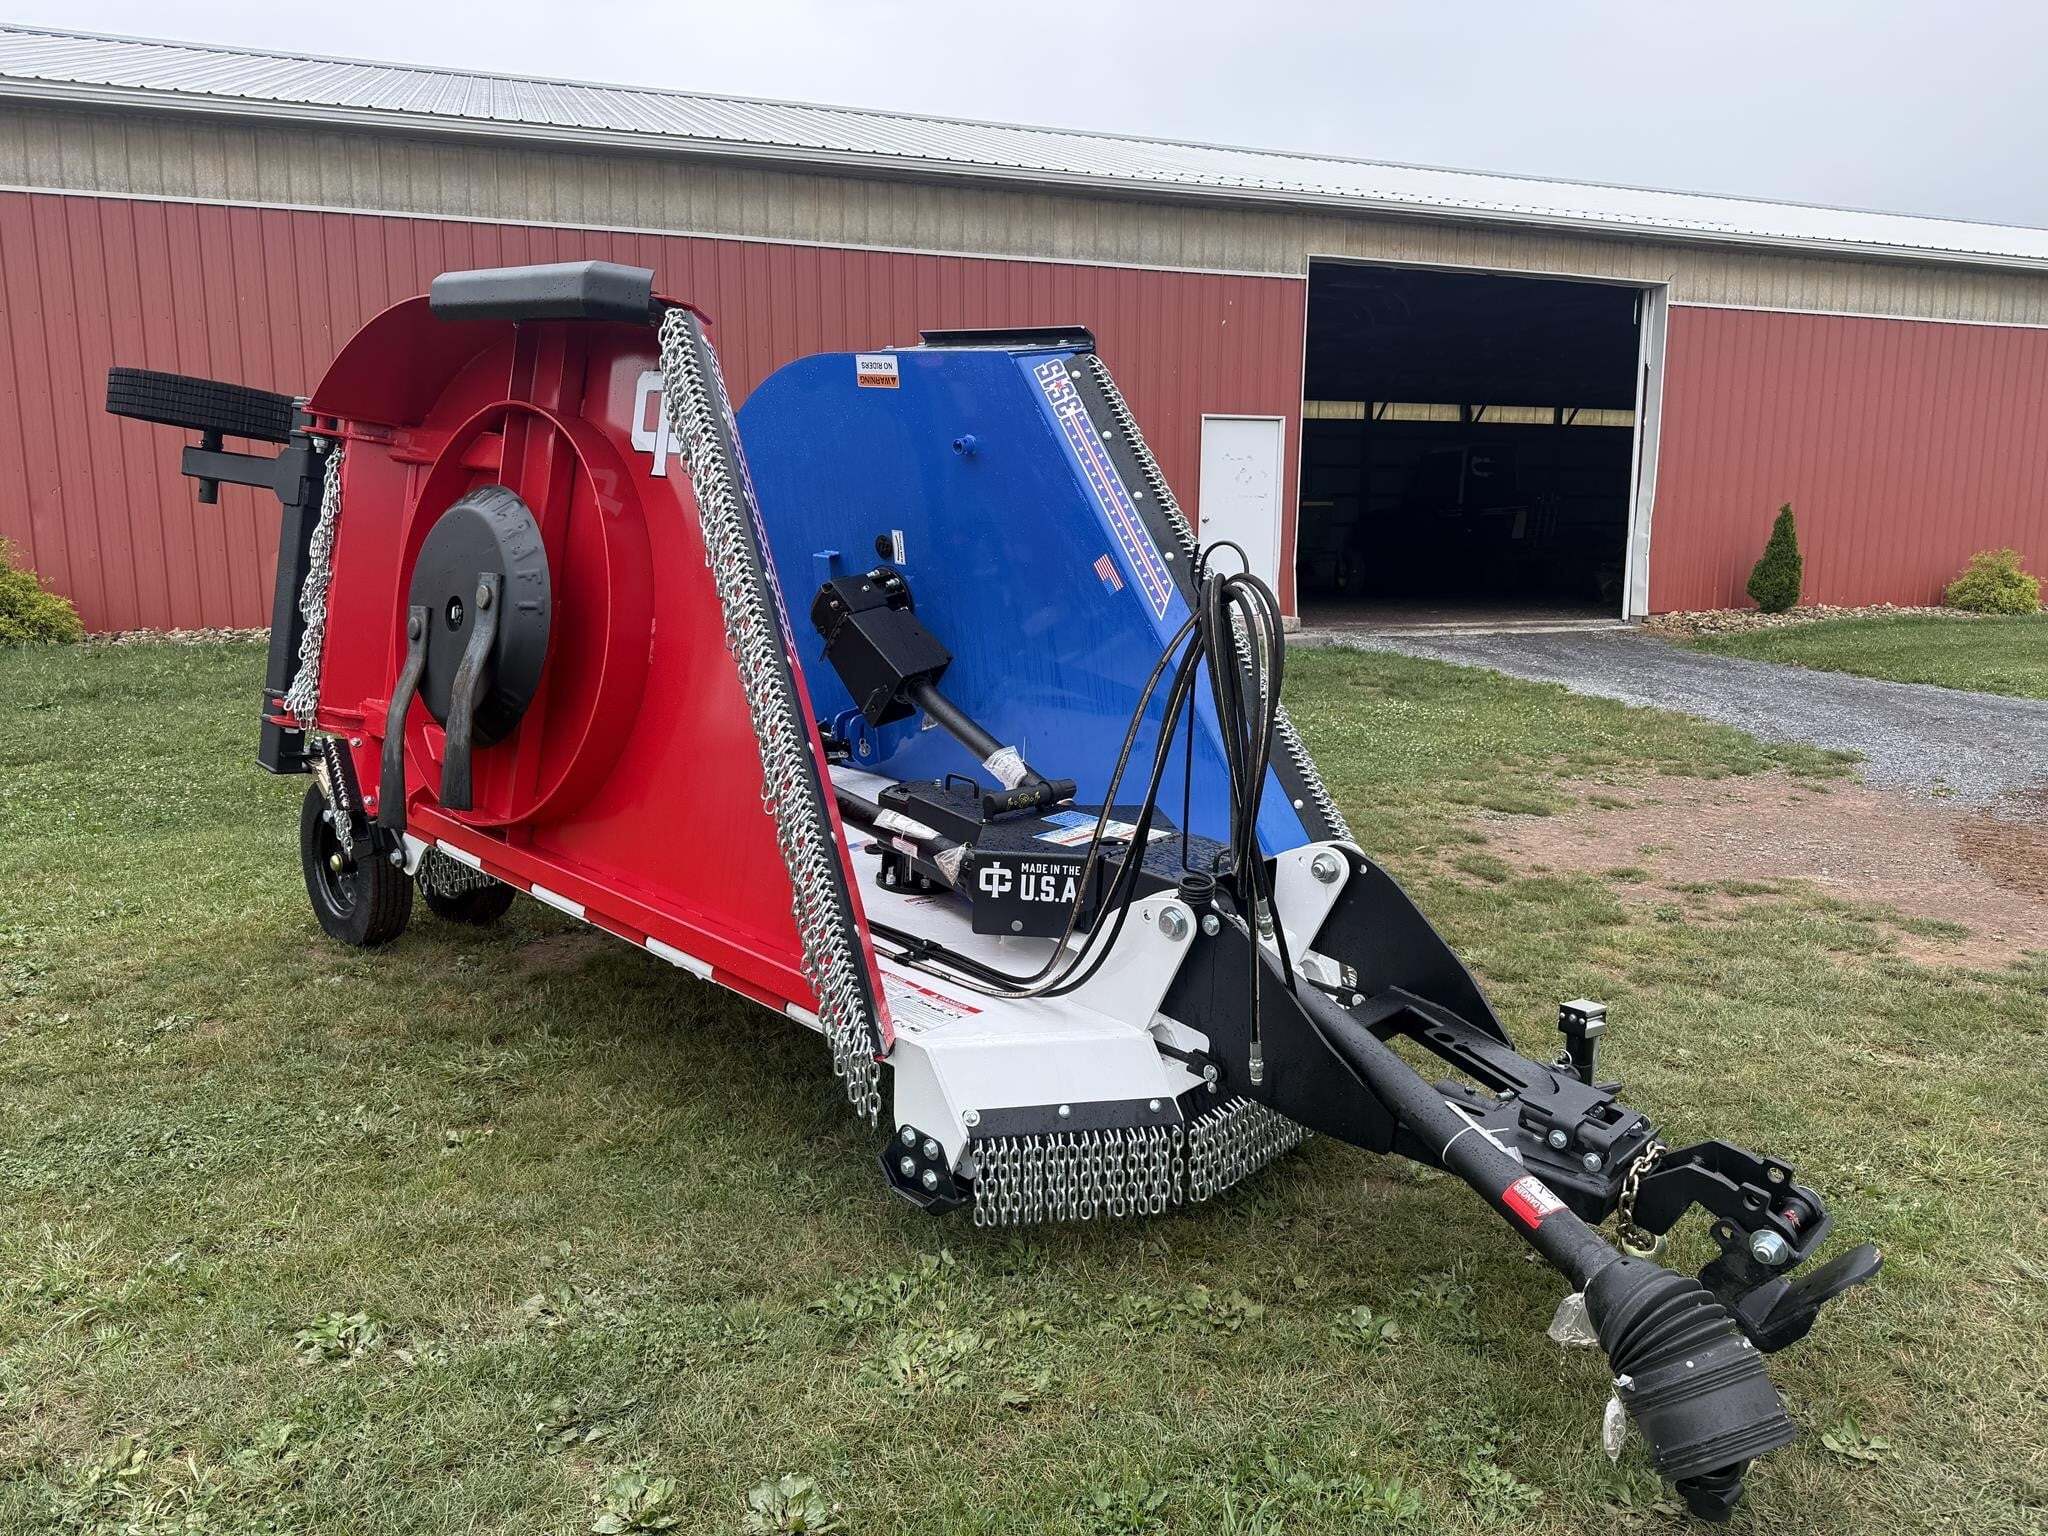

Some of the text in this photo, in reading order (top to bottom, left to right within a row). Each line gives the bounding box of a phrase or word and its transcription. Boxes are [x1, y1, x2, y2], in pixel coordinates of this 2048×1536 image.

[861, 362, 893, 370] NO RIDERS
[859, 376, 891, 385] WARNING
[1021, 863, 1081, 876] MADE IN THE
